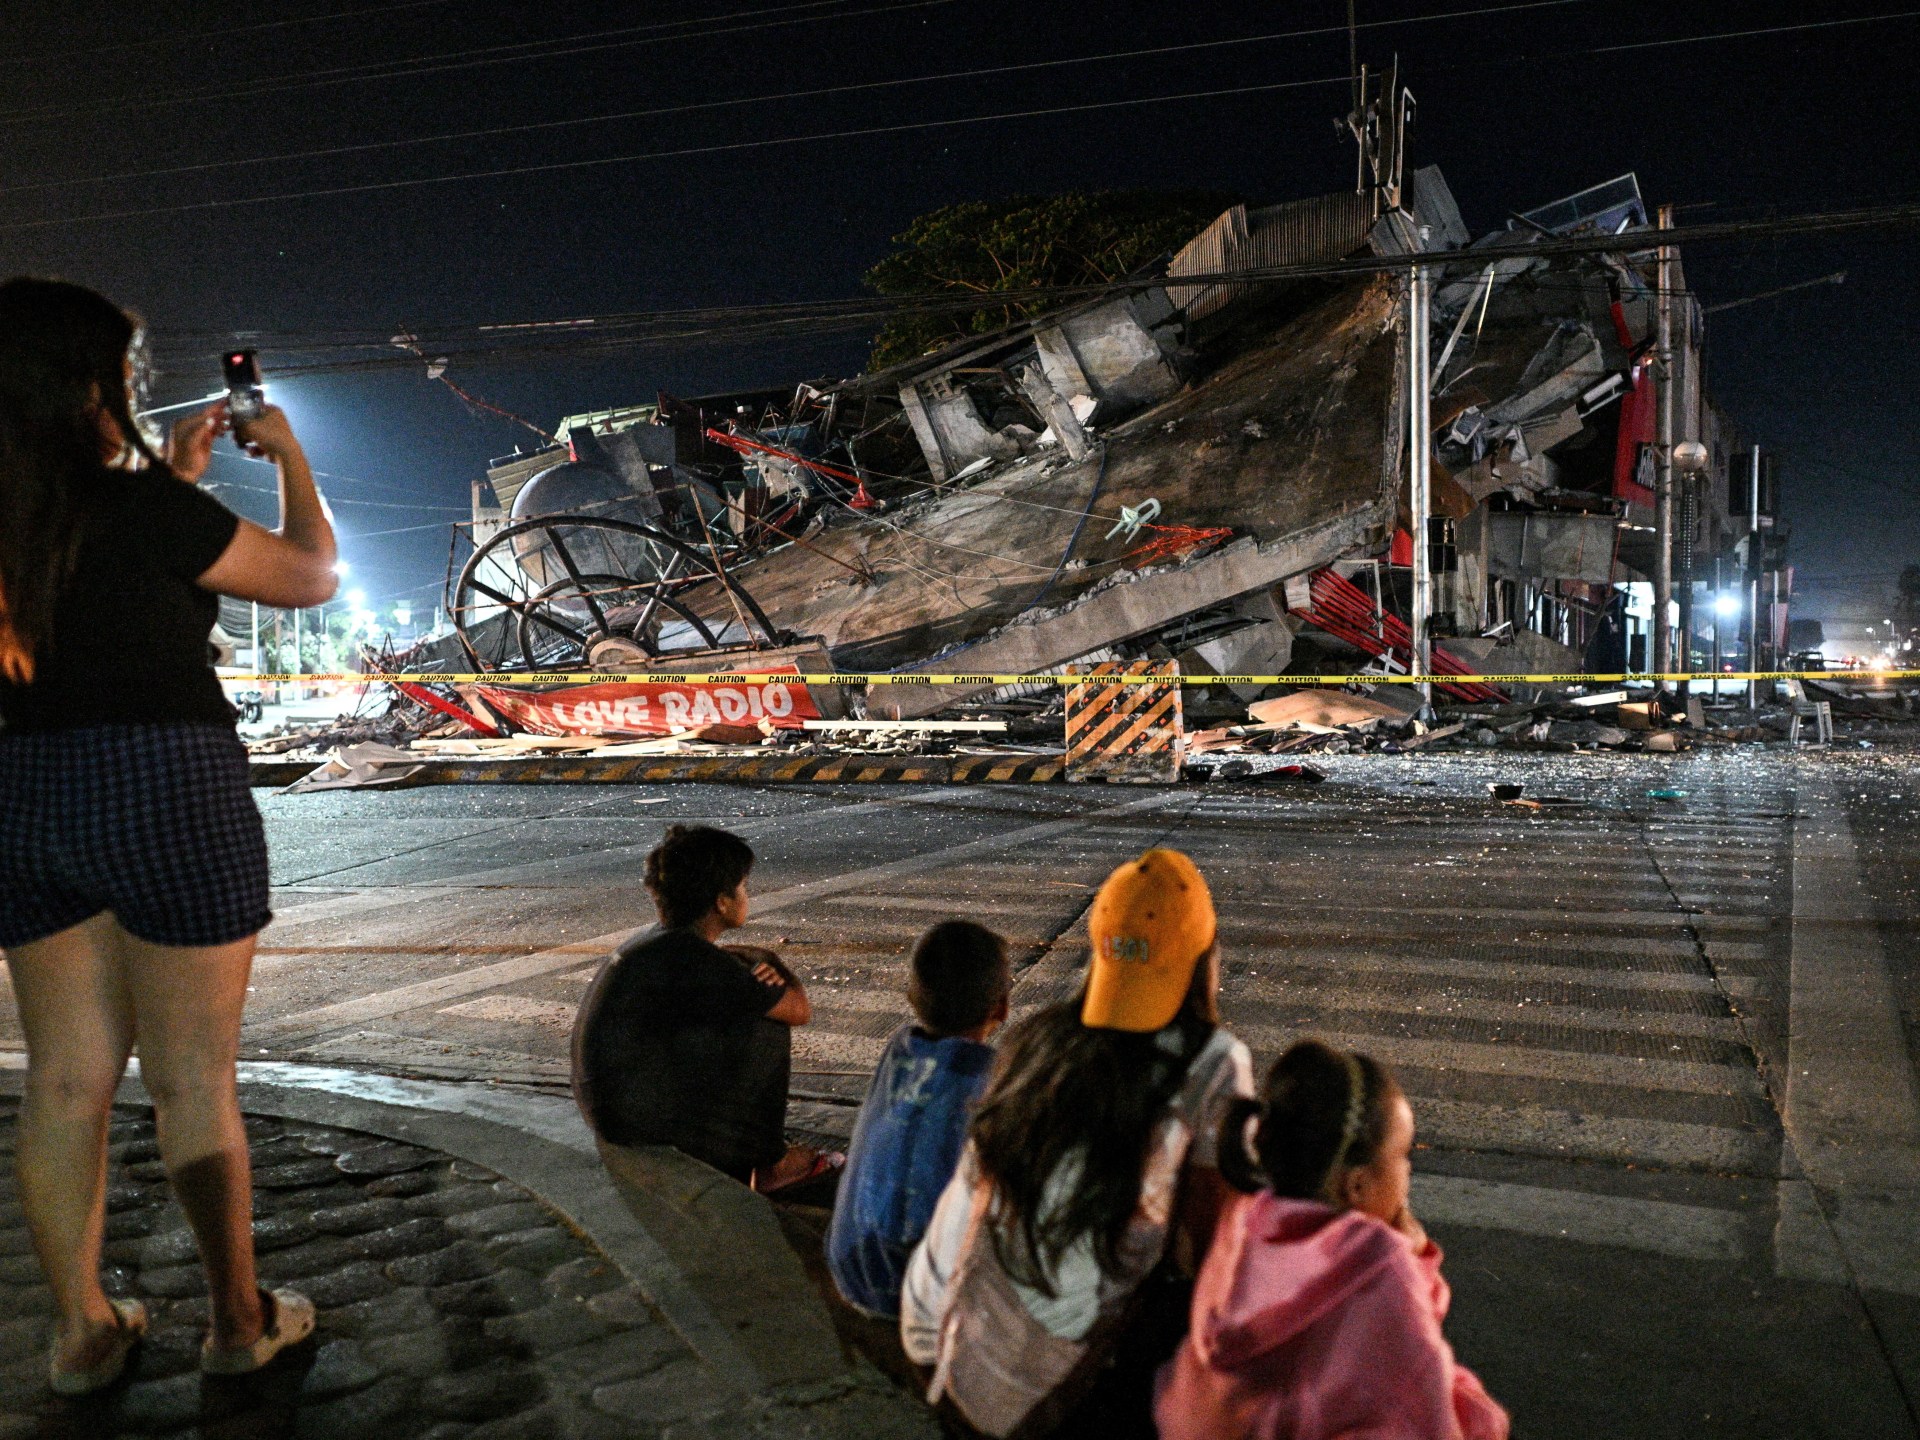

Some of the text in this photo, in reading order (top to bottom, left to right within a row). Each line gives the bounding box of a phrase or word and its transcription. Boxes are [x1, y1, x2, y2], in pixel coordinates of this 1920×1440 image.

[590, 675, 627, 683] CAUTION
[649, 675, 686, 683] CAUTION
[708, 675, 746, 683] CAUTION
[768, 675, 806, 684] CAUTION
[830, 676, 868, 684] CAUTION
[891, 676, 931, 684] CAUTION
[954, 676, 993, 684] CAUTION
[1018, 676, 1057, 684] CAUTION
[1082, 676, 1122, 684] CAUTION
[552, 684, 793, 728] LOVE RADIO
